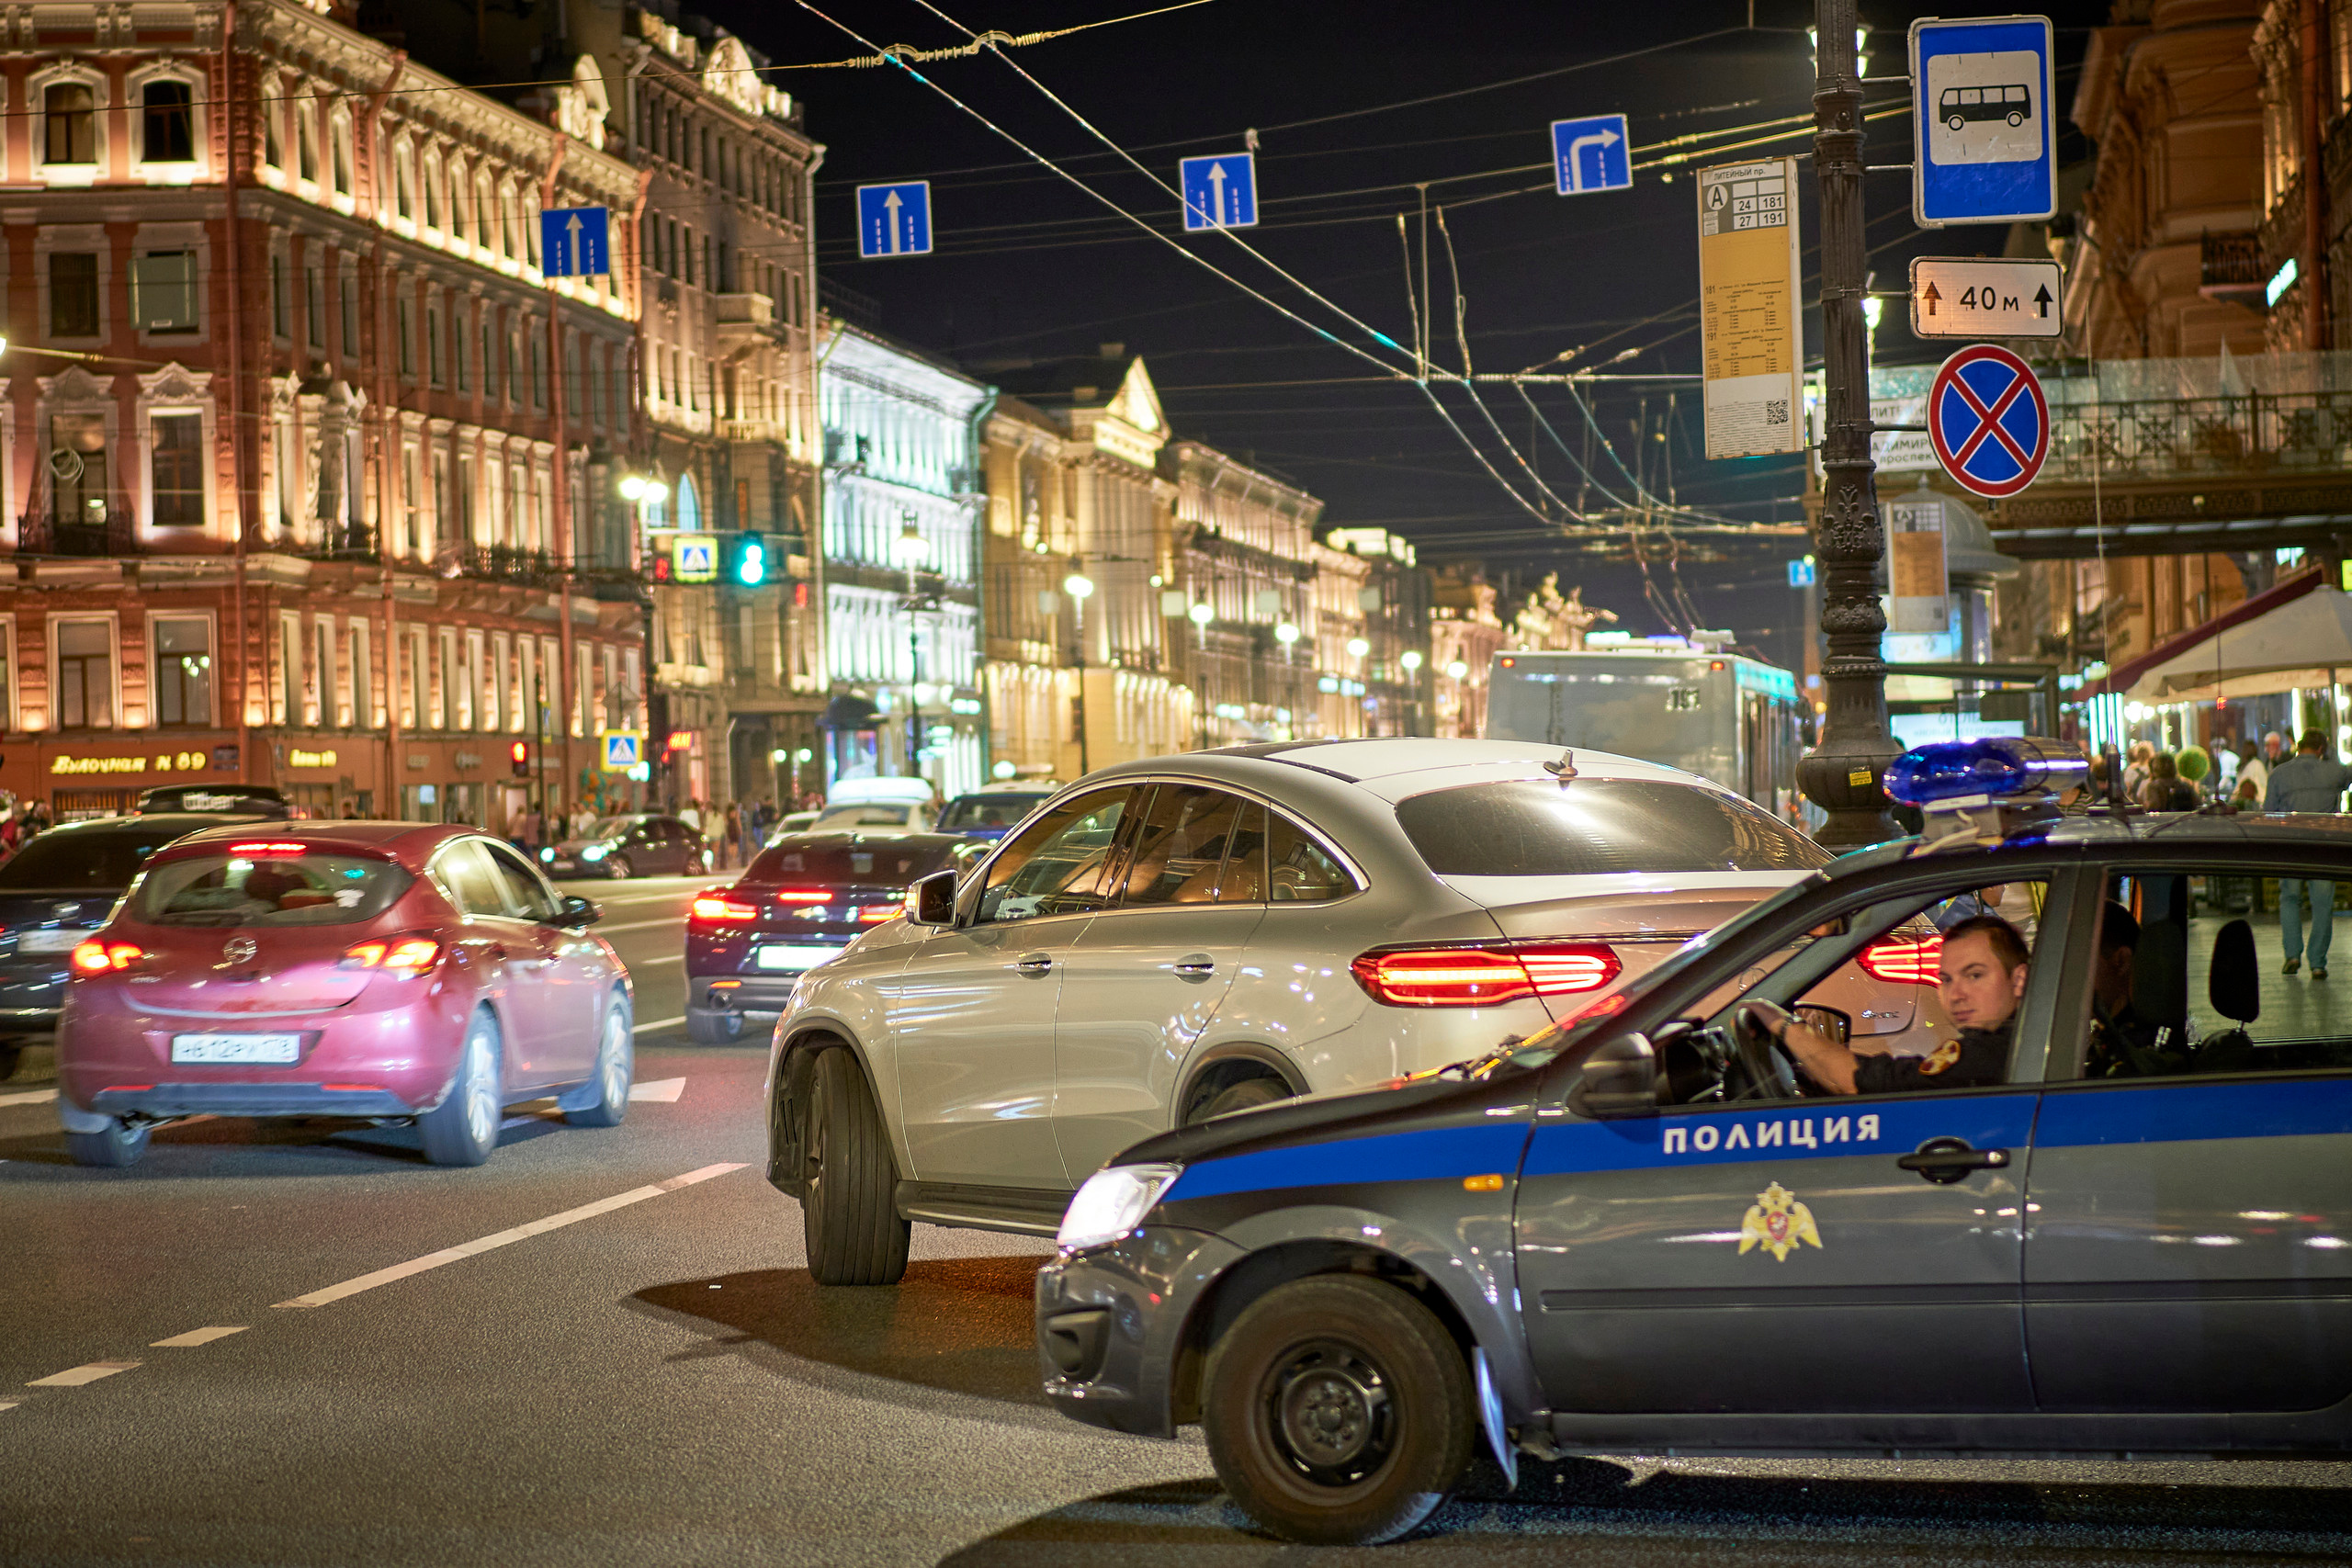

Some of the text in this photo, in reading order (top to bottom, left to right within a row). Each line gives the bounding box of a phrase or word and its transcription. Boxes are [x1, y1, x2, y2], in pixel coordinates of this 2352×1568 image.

[1713, 167, 1766, 181] ЛИТЕЙНЫЙ пр.
[1739, 197, 1782, 211] 24 181
[1739, 212, 1782, 227] 27 191
[1960, 287, 1996, 310] 40
[1707, 333, 1717, 342] 191
[1880, 453, 1933, 465] проспек
[1663, 1113, 1880, 1155] ПОЛИЦИЯ
